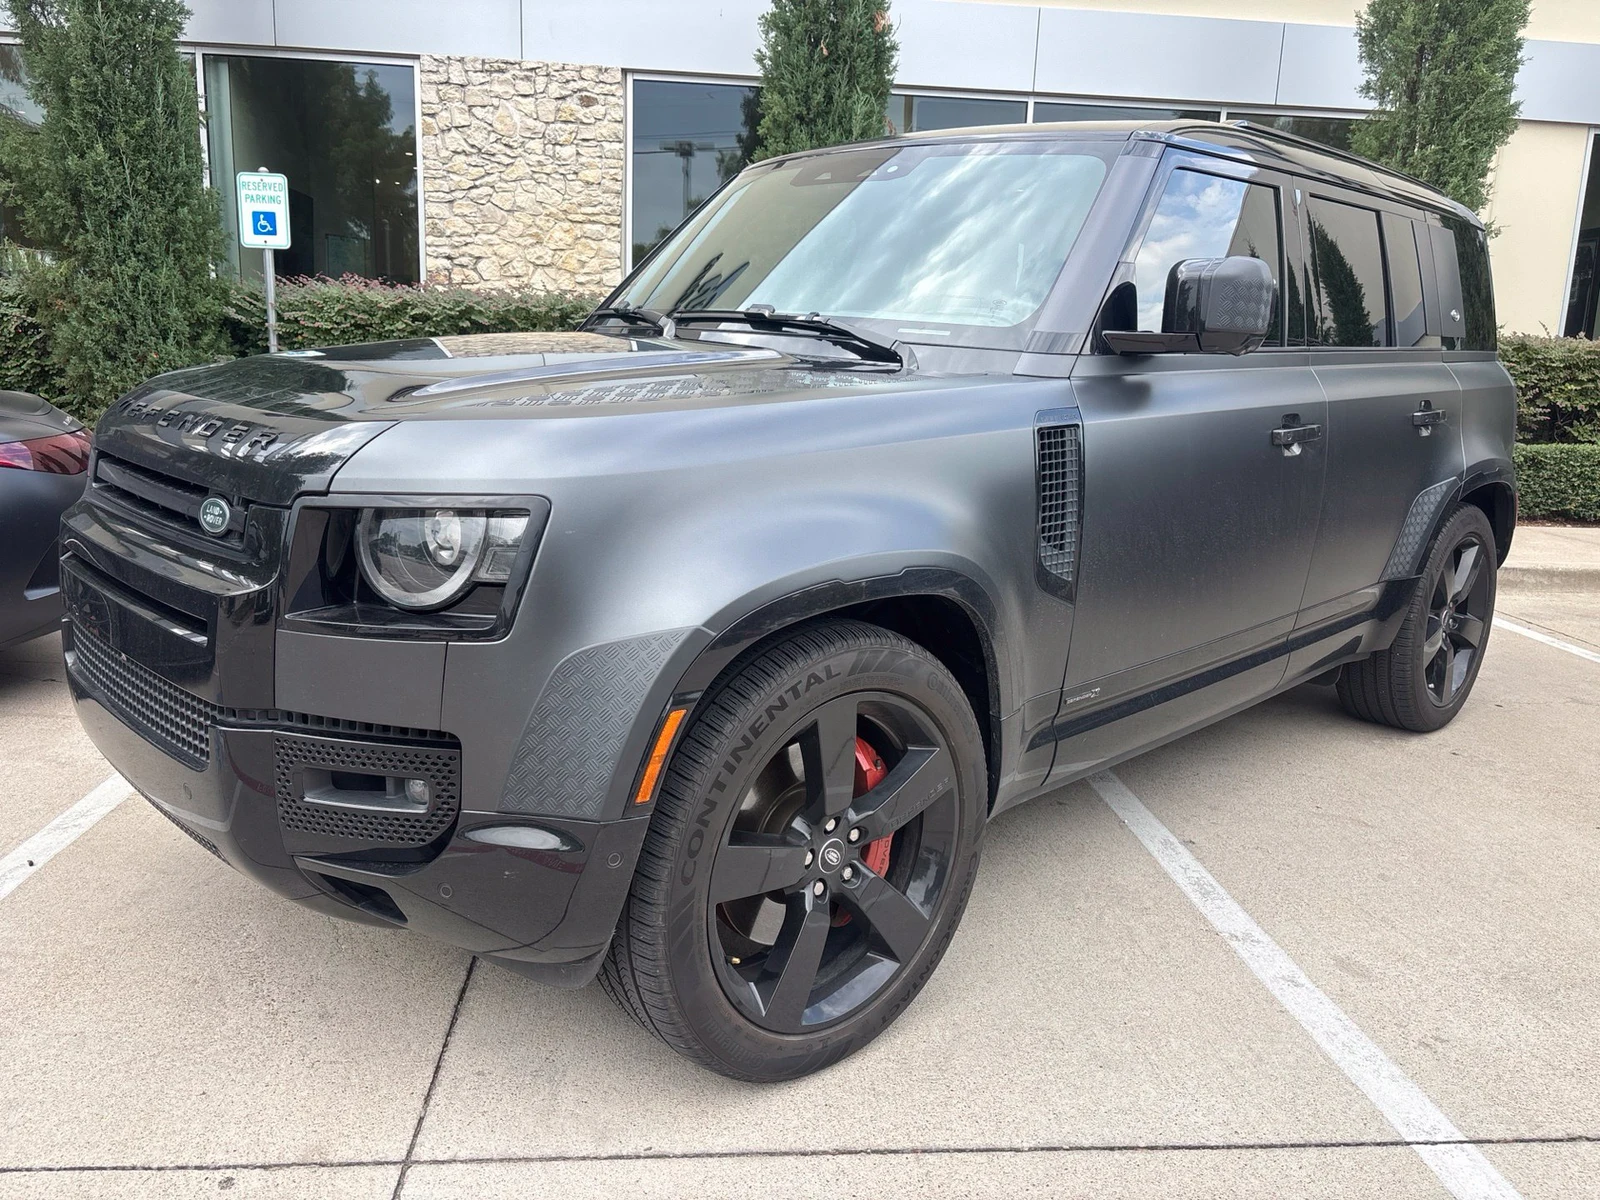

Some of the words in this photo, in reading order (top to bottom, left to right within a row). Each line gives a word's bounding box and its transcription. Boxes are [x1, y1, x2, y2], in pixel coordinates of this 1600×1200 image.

[241, 181, 284, 192] RESERVED
[244, 193, 282, 205] PARKING
[680, 664, 842, 886] CONTINENTAL
